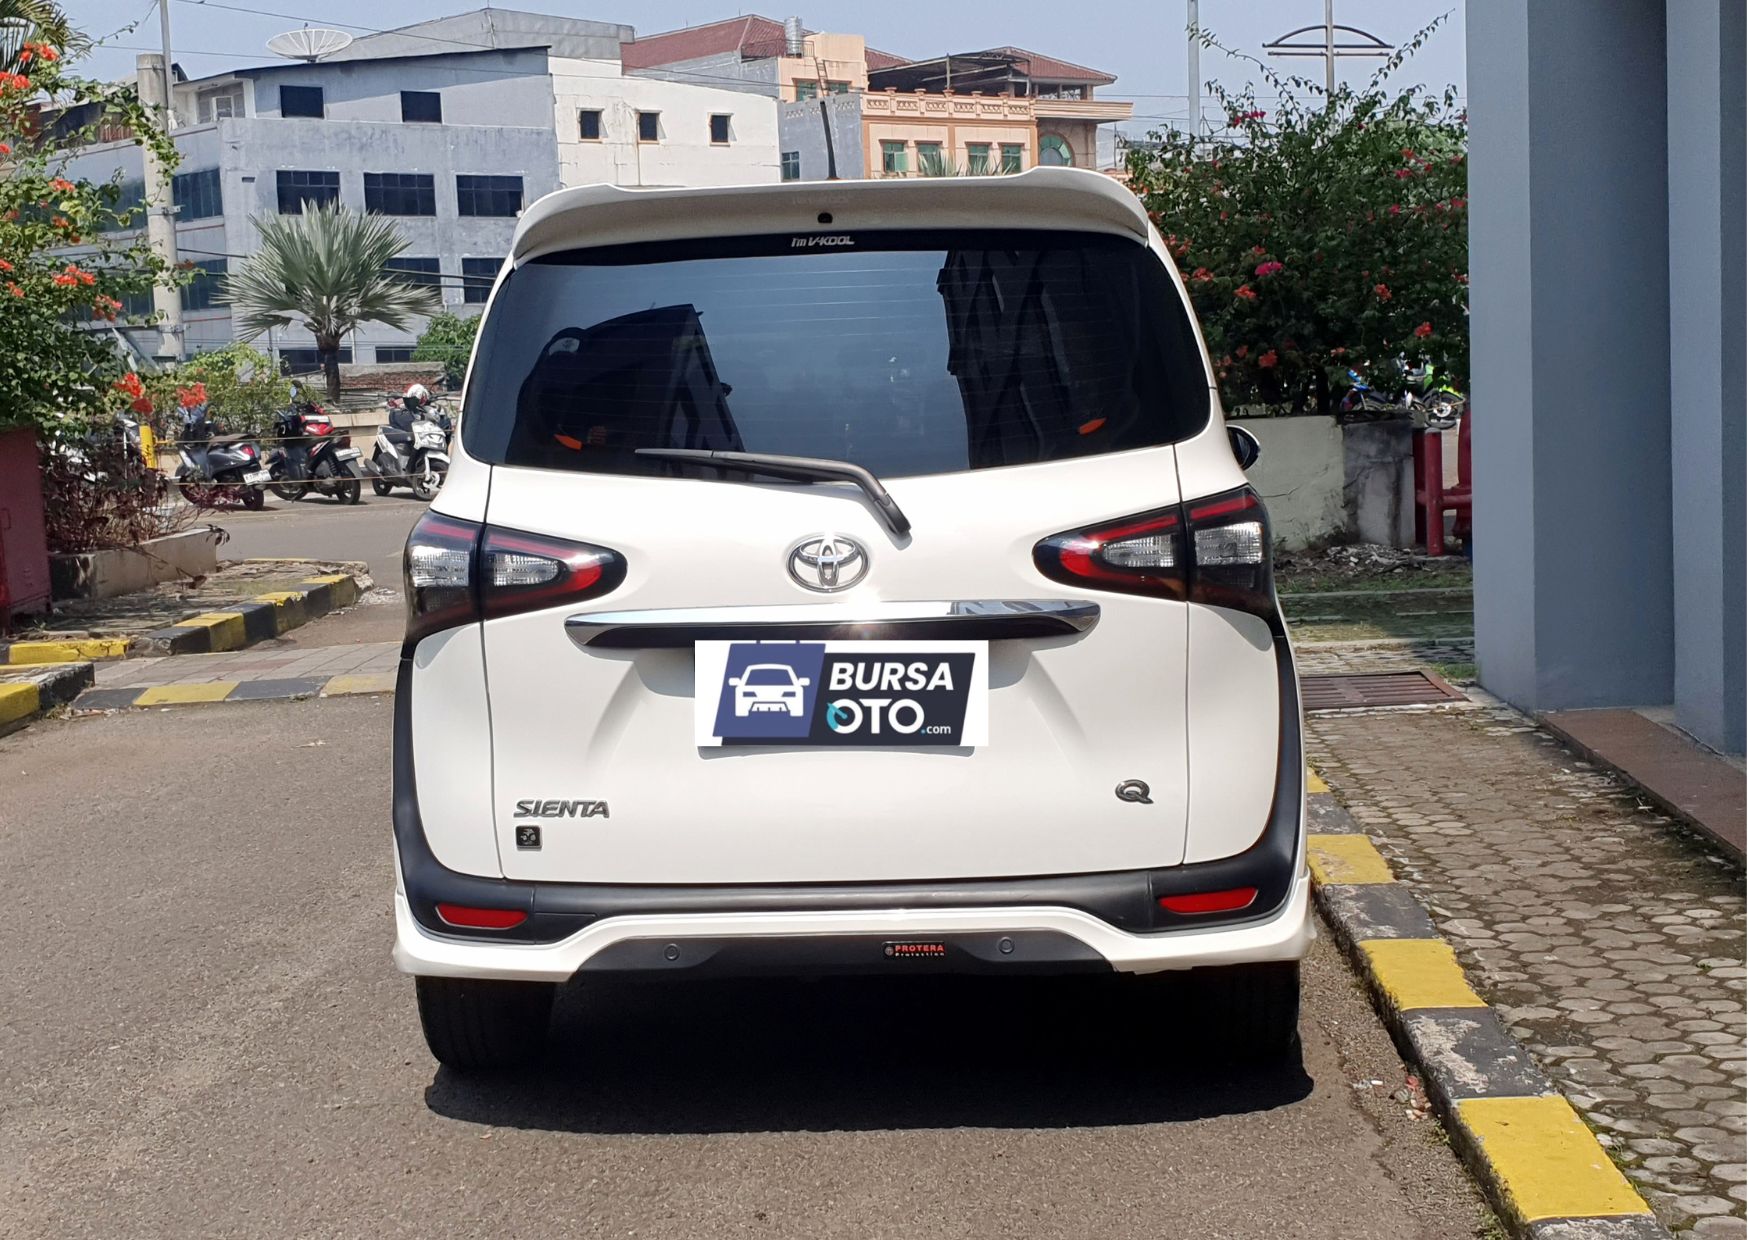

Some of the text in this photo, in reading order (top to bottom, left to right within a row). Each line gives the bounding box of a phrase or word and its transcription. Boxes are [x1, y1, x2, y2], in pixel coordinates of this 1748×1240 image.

[808, 235, 855, 246] V-KOOL
[1115, 779, 1154, 804] Q
[513, 799, 610, 818] SIENTA
[895, 944, 945, 952] PROTERA
